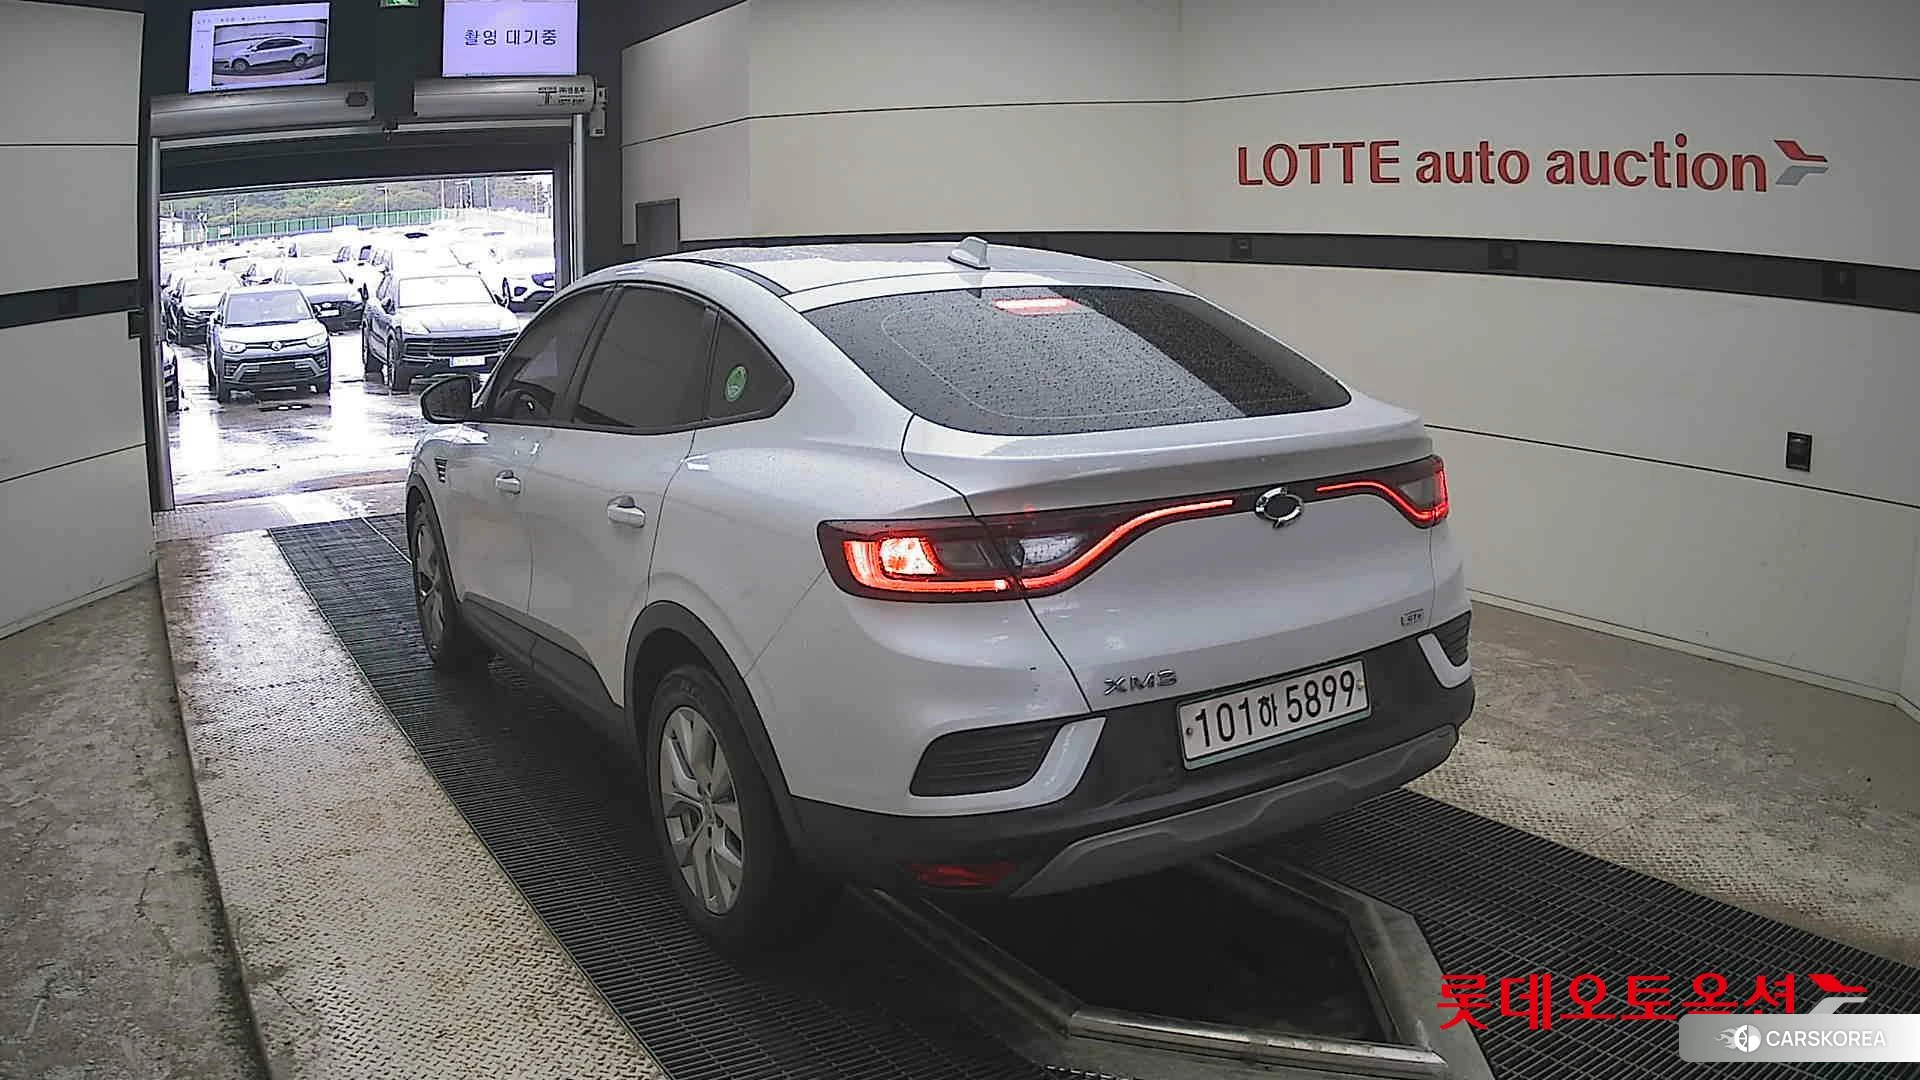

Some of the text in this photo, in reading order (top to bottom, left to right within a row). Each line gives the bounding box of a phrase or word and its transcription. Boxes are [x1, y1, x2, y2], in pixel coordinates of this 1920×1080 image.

[464, 29, 558, 46] 촬영 대기중
[1237, 133, 1768, 193] LOTTE auto auction
[1104, 668, 1177, 696] XM3
